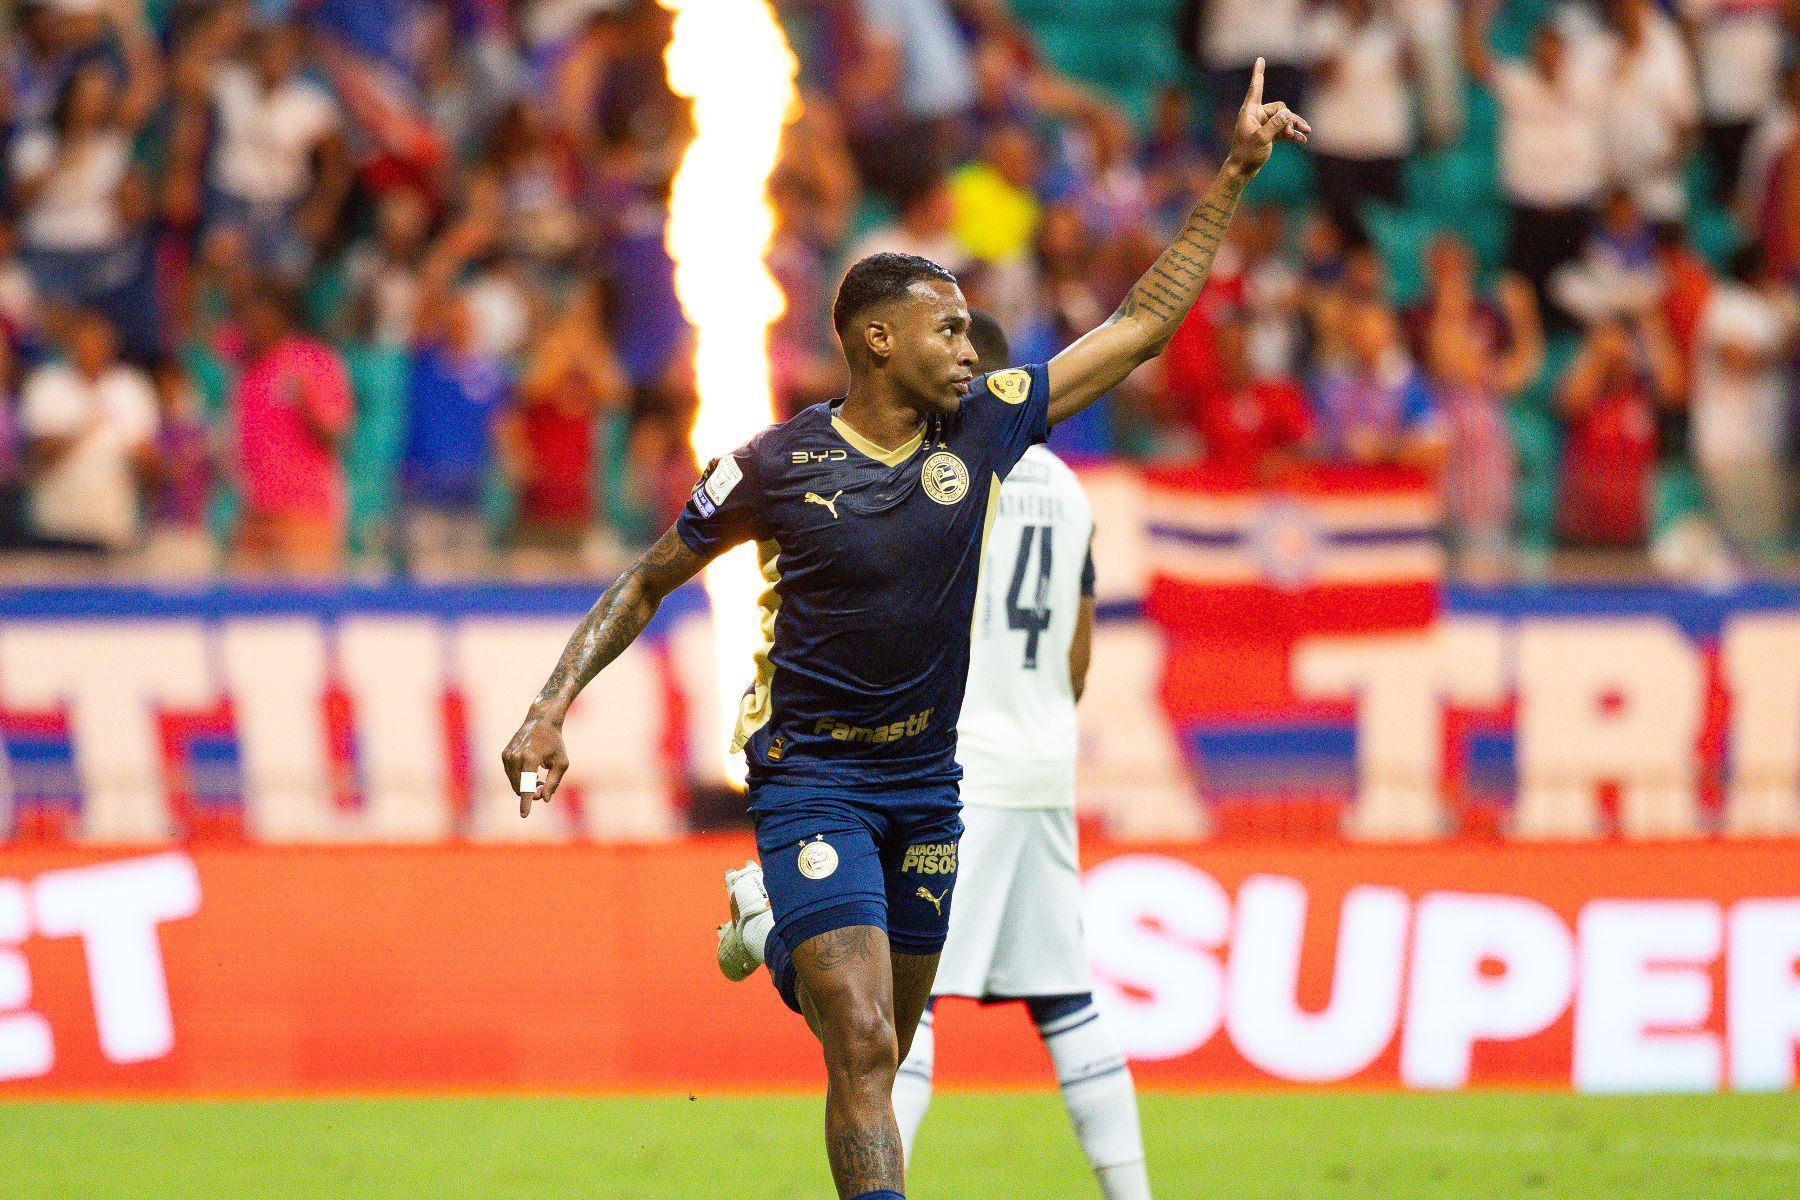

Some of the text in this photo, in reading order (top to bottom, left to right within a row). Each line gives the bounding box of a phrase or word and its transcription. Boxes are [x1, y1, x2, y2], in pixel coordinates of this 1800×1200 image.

[791, 450, 848, 464] BYD
[925, 456, 966, 497] ESPORTE CLUBE BAHIA
[1006, 524, 1053, 669] 4
[813, 710, 931, 744] Famastil
[901, 855, 957, 875] PISOS
